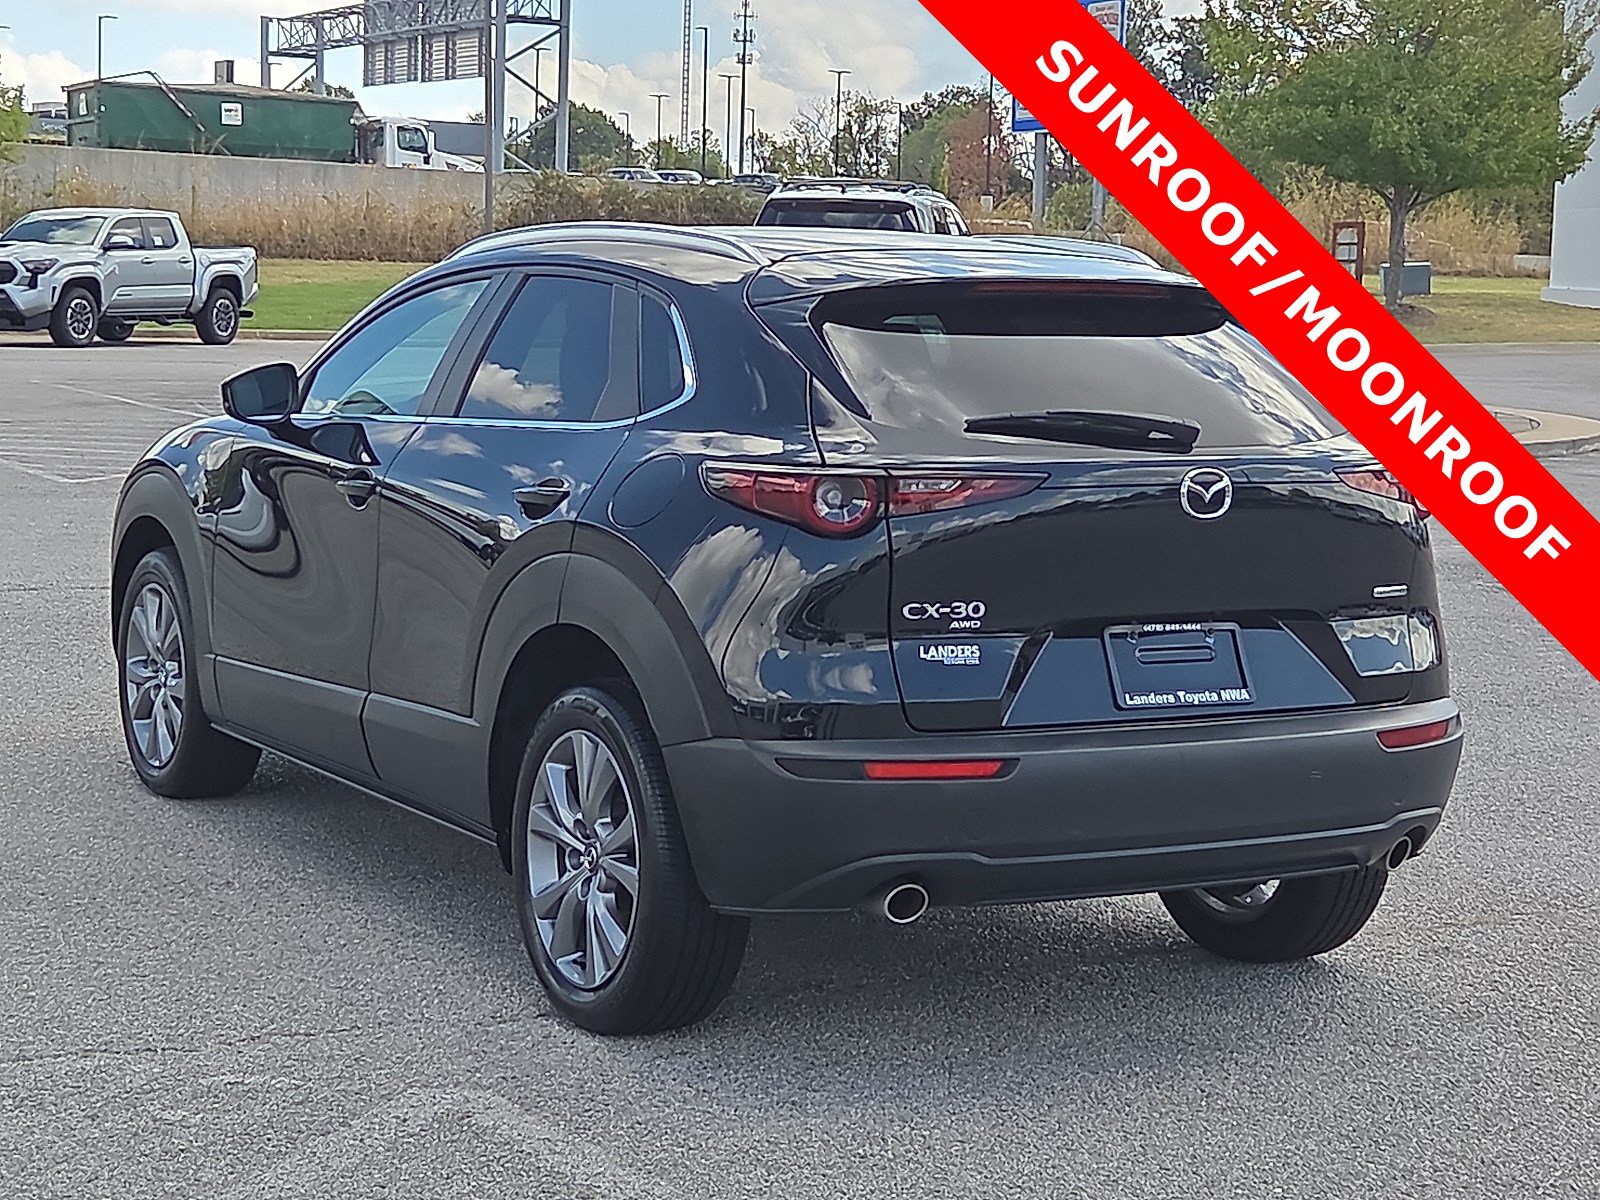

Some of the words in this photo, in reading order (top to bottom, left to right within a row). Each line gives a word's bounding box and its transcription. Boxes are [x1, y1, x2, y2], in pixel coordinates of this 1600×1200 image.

[902, 601, 986, 620] CX-30
[948, 620, 982, 629] AWD
[919, 644, 980, 660] LANDERS
[1124, 692, 1176, 705] Landers
[1176, 689, 1219, 705] Toyota
[1220, 688, 1251, 701] NWA
